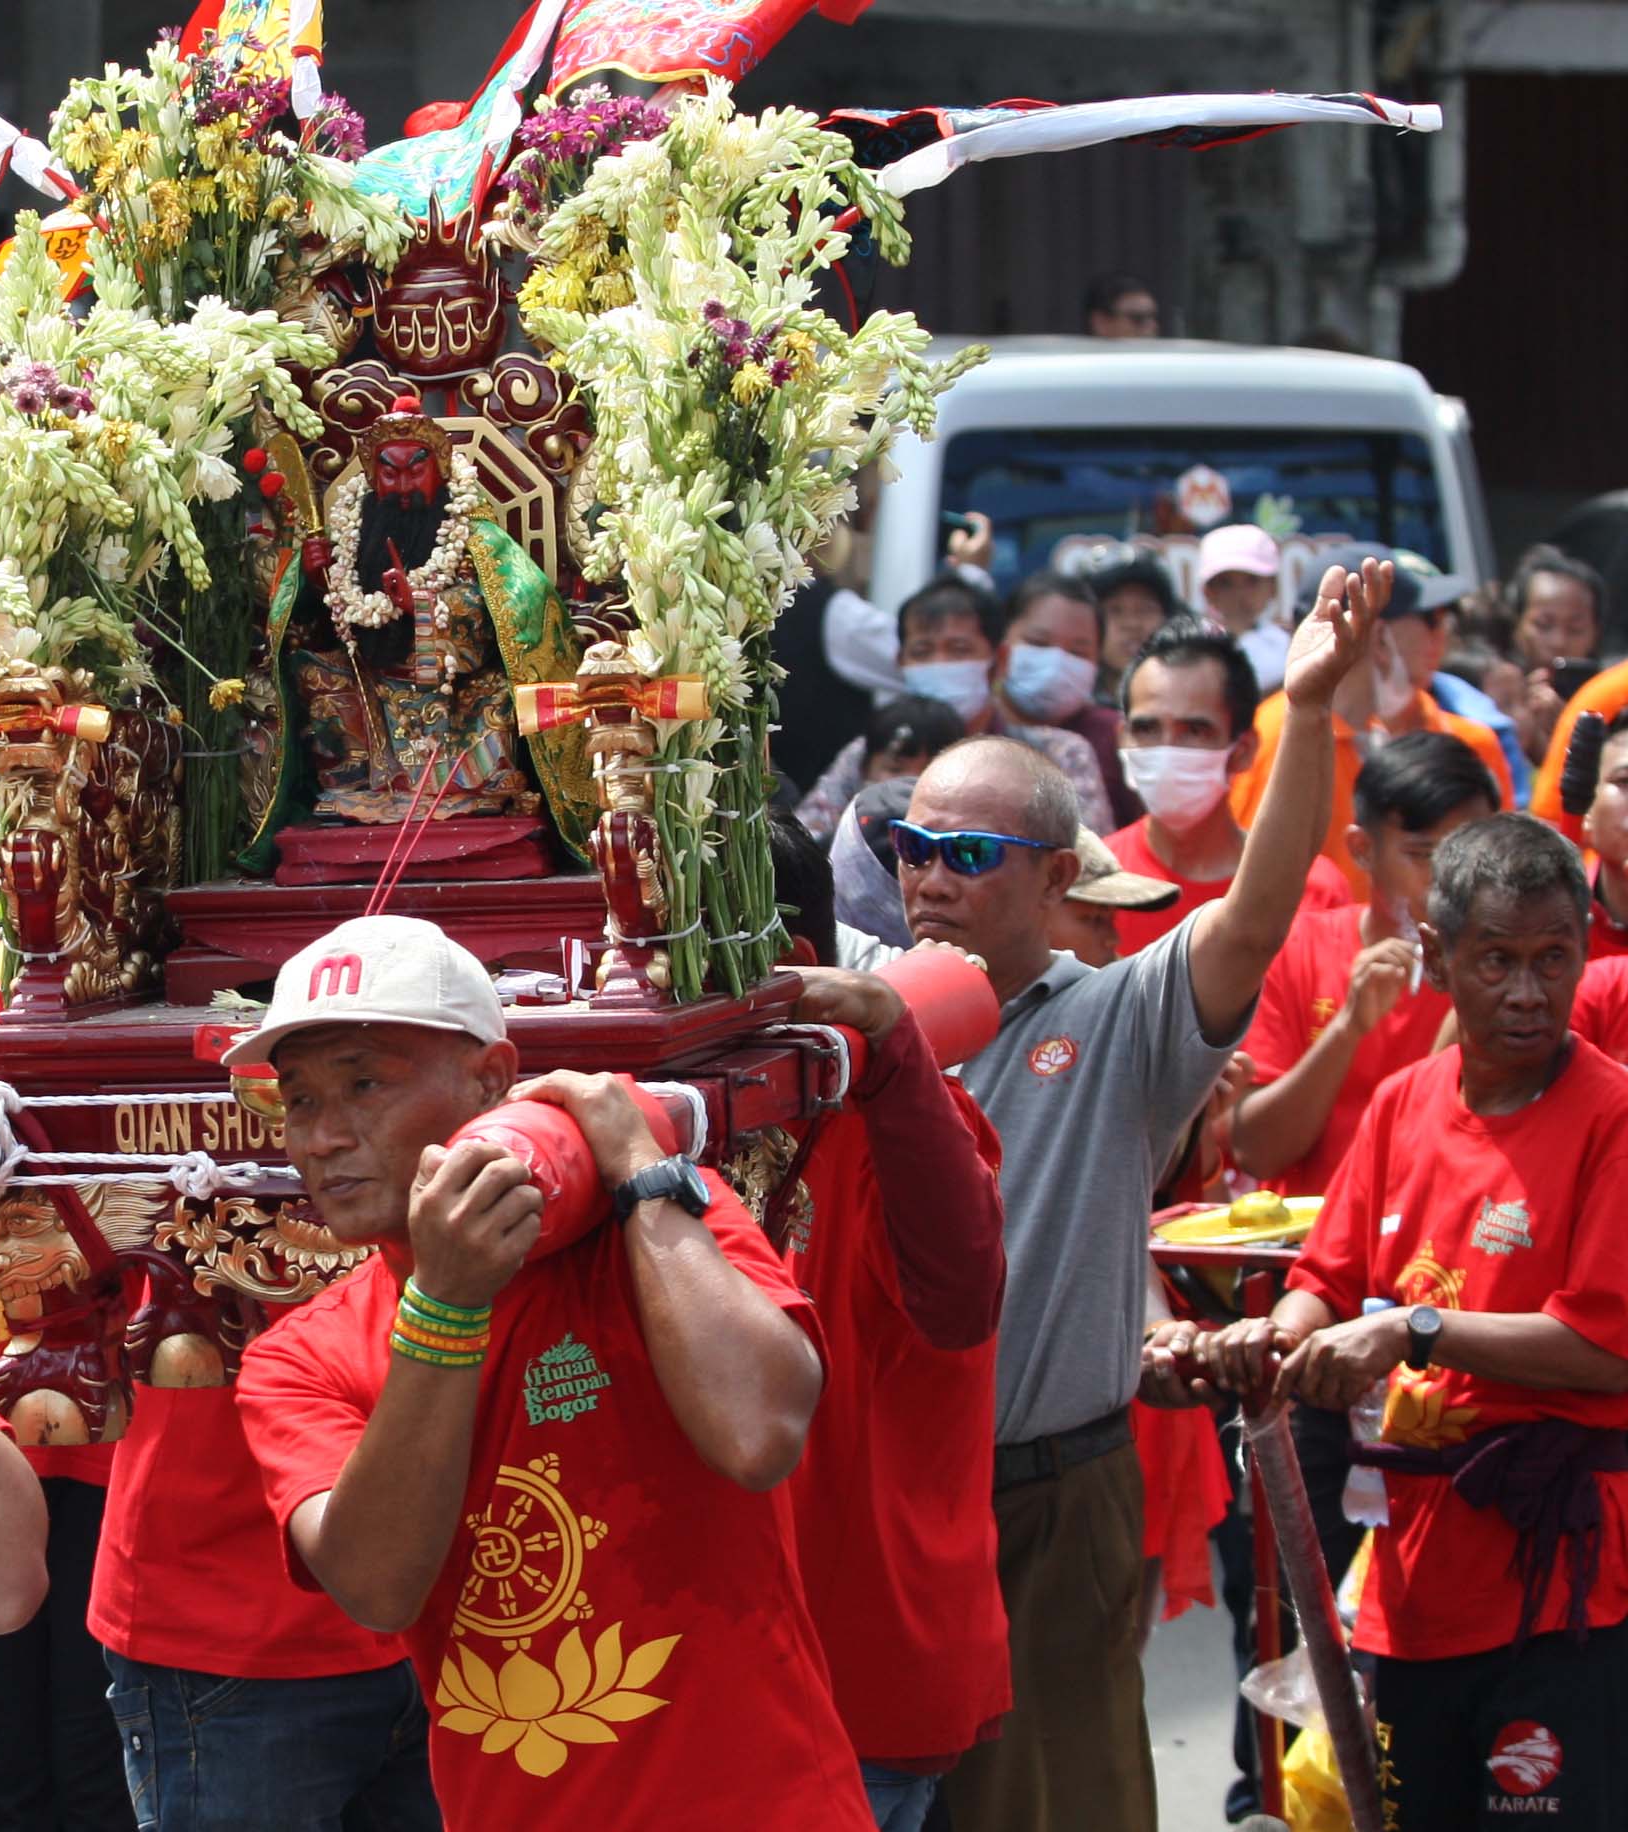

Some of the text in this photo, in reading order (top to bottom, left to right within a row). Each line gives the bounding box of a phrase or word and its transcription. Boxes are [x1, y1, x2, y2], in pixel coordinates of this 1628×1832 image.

[115, 1102, 192, 1153] QIAN
[523, 1370, 612, 1404] Rempah
[527, 1395, 599, 1426] Bogor
[1487, 1796, 1560, 1814] KARATE
